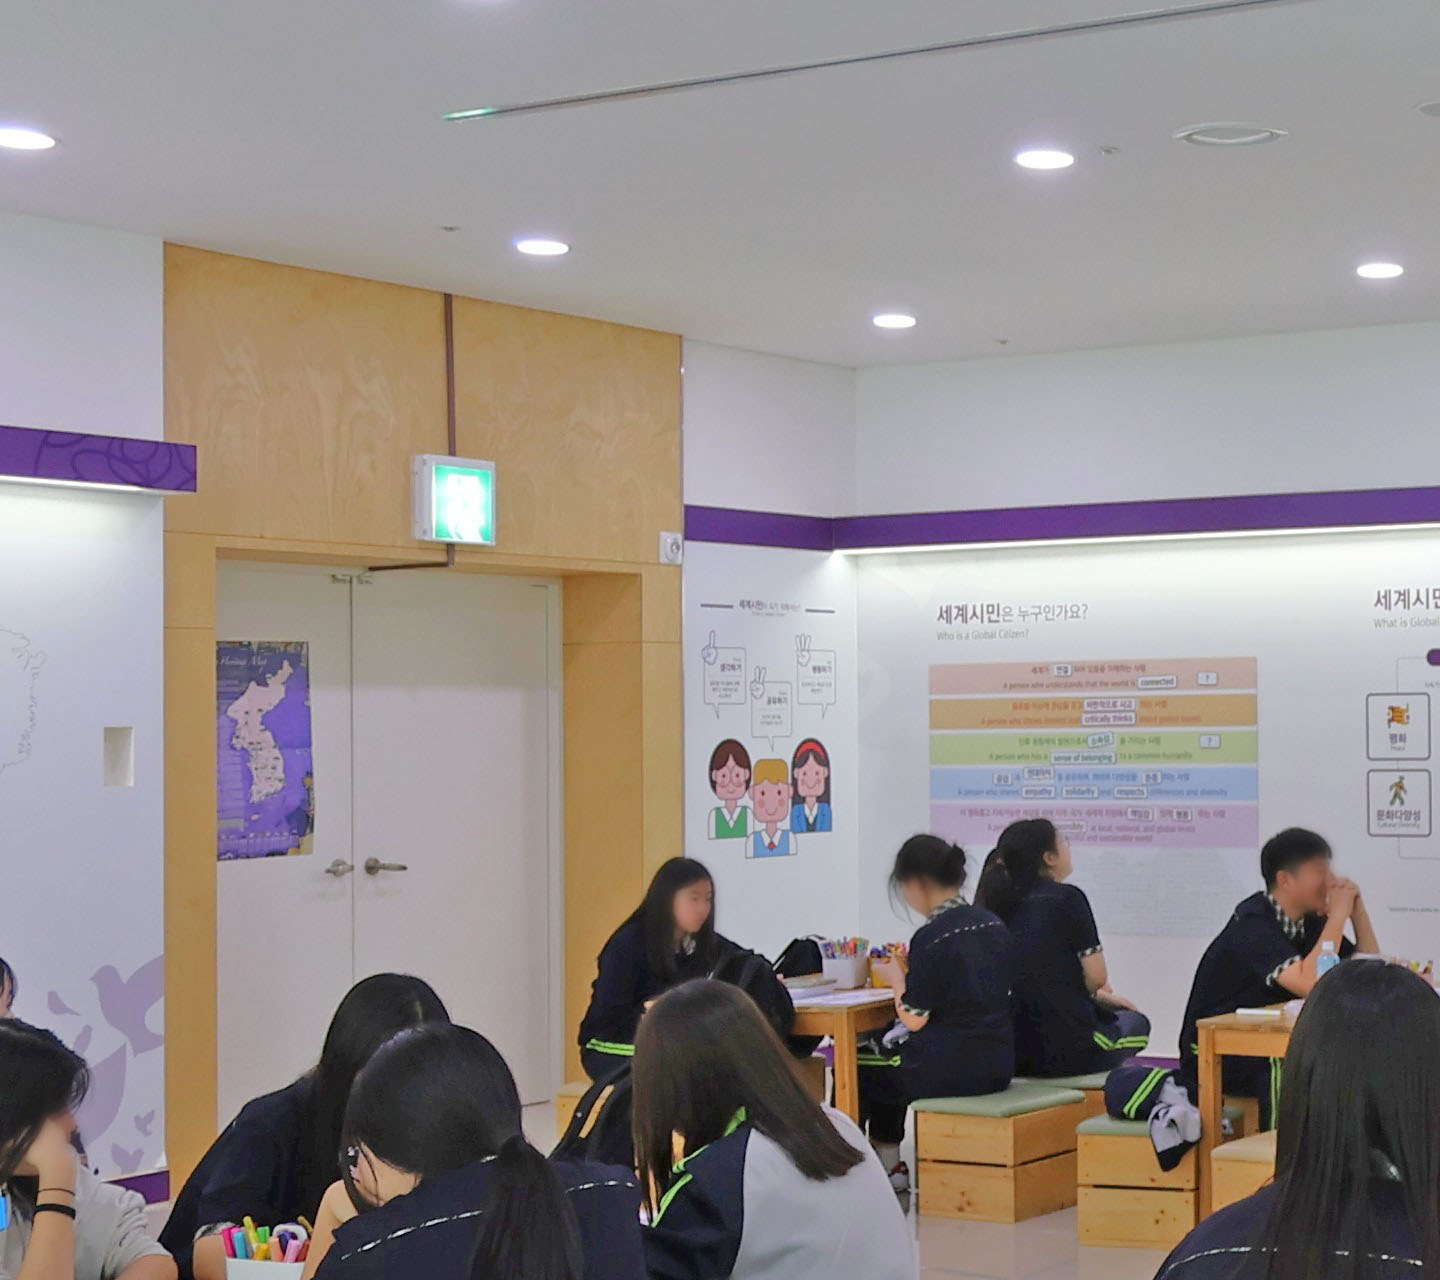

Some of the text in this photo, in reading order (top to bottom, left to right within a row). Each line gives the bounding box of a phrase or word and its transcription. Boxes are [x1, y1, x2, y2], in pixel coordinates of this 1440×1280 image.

[936, 603, 1089, 624] 세계시민은 누구인가요?
[1374, 618, 1398, 629] What
[1400, 618, 1408, 628] is
[1410, 616, 1440, 628] Global
[936, 628, 1030, 640] Who is a Global Citizen?
[1140, 678, 1174, 686] connected
[1388, 732, 1407, 745] 평화
[1376, 809, 1421, 822] 문화다양성
